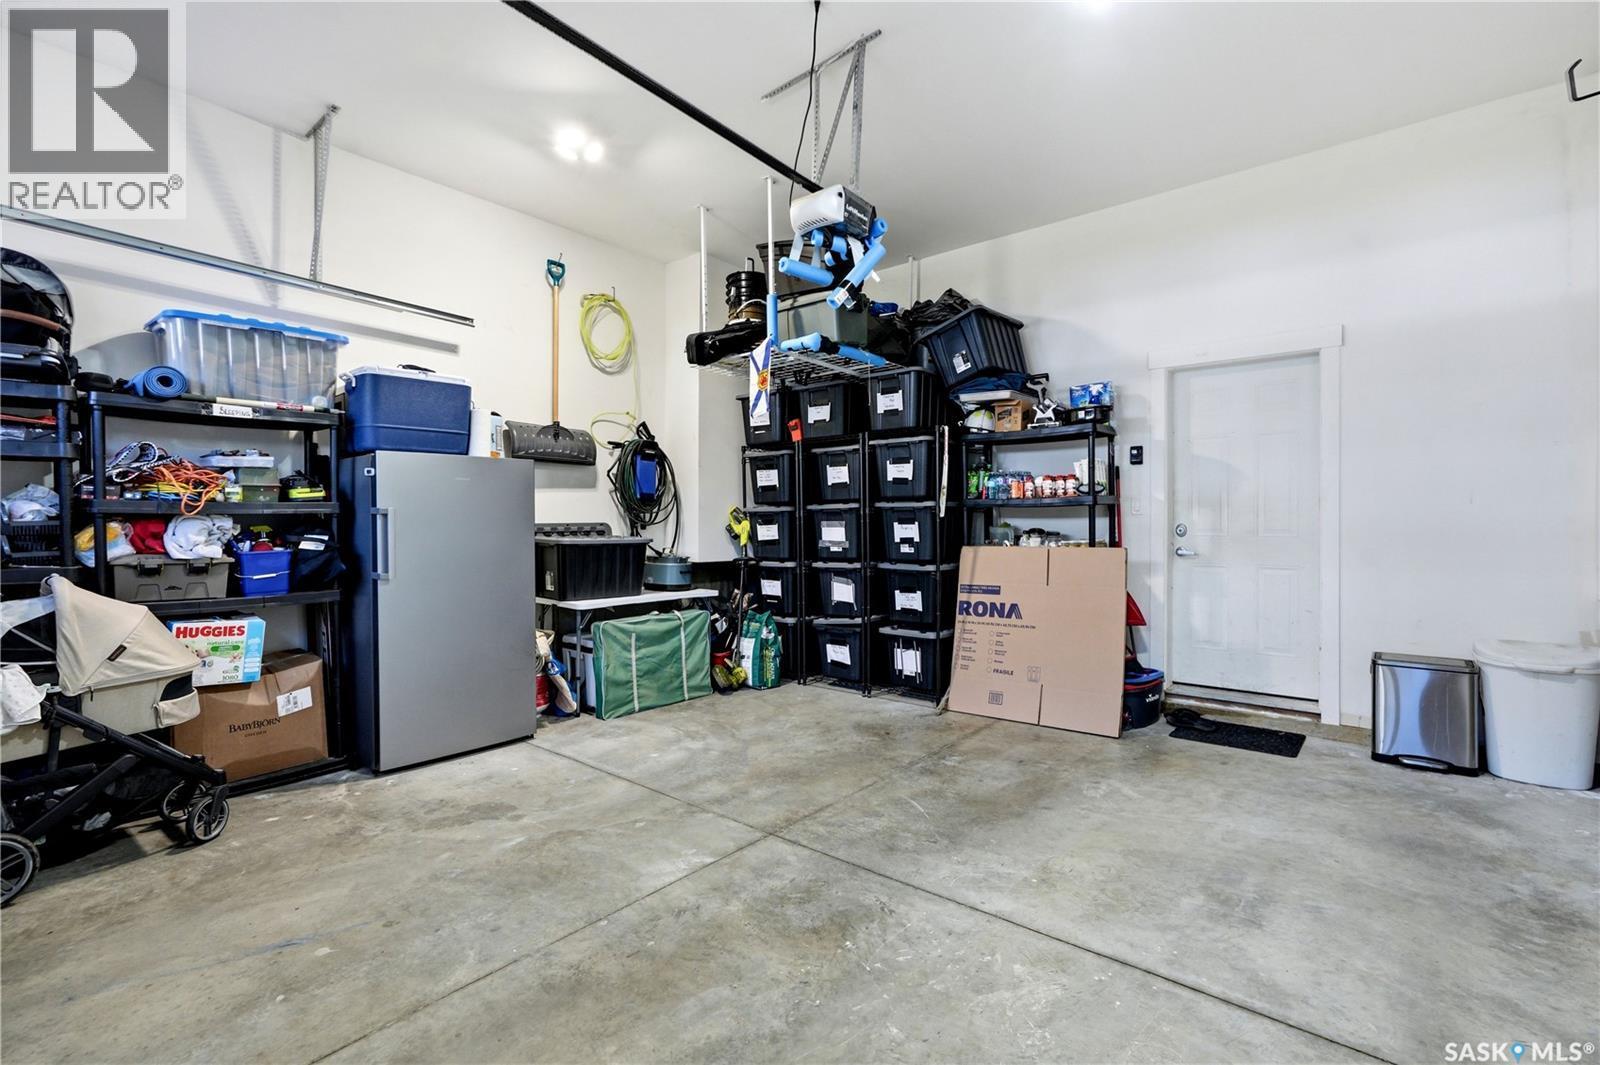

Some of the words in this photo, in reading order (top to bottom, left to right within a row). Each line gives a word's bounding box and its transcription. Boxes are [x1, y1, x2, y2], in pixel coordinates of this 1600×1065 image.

[958, 600, 1023, 620] RONA
[175, 625, 246, 639] HUGGIES
[993, 668, 1014, 676] FRAGILE
